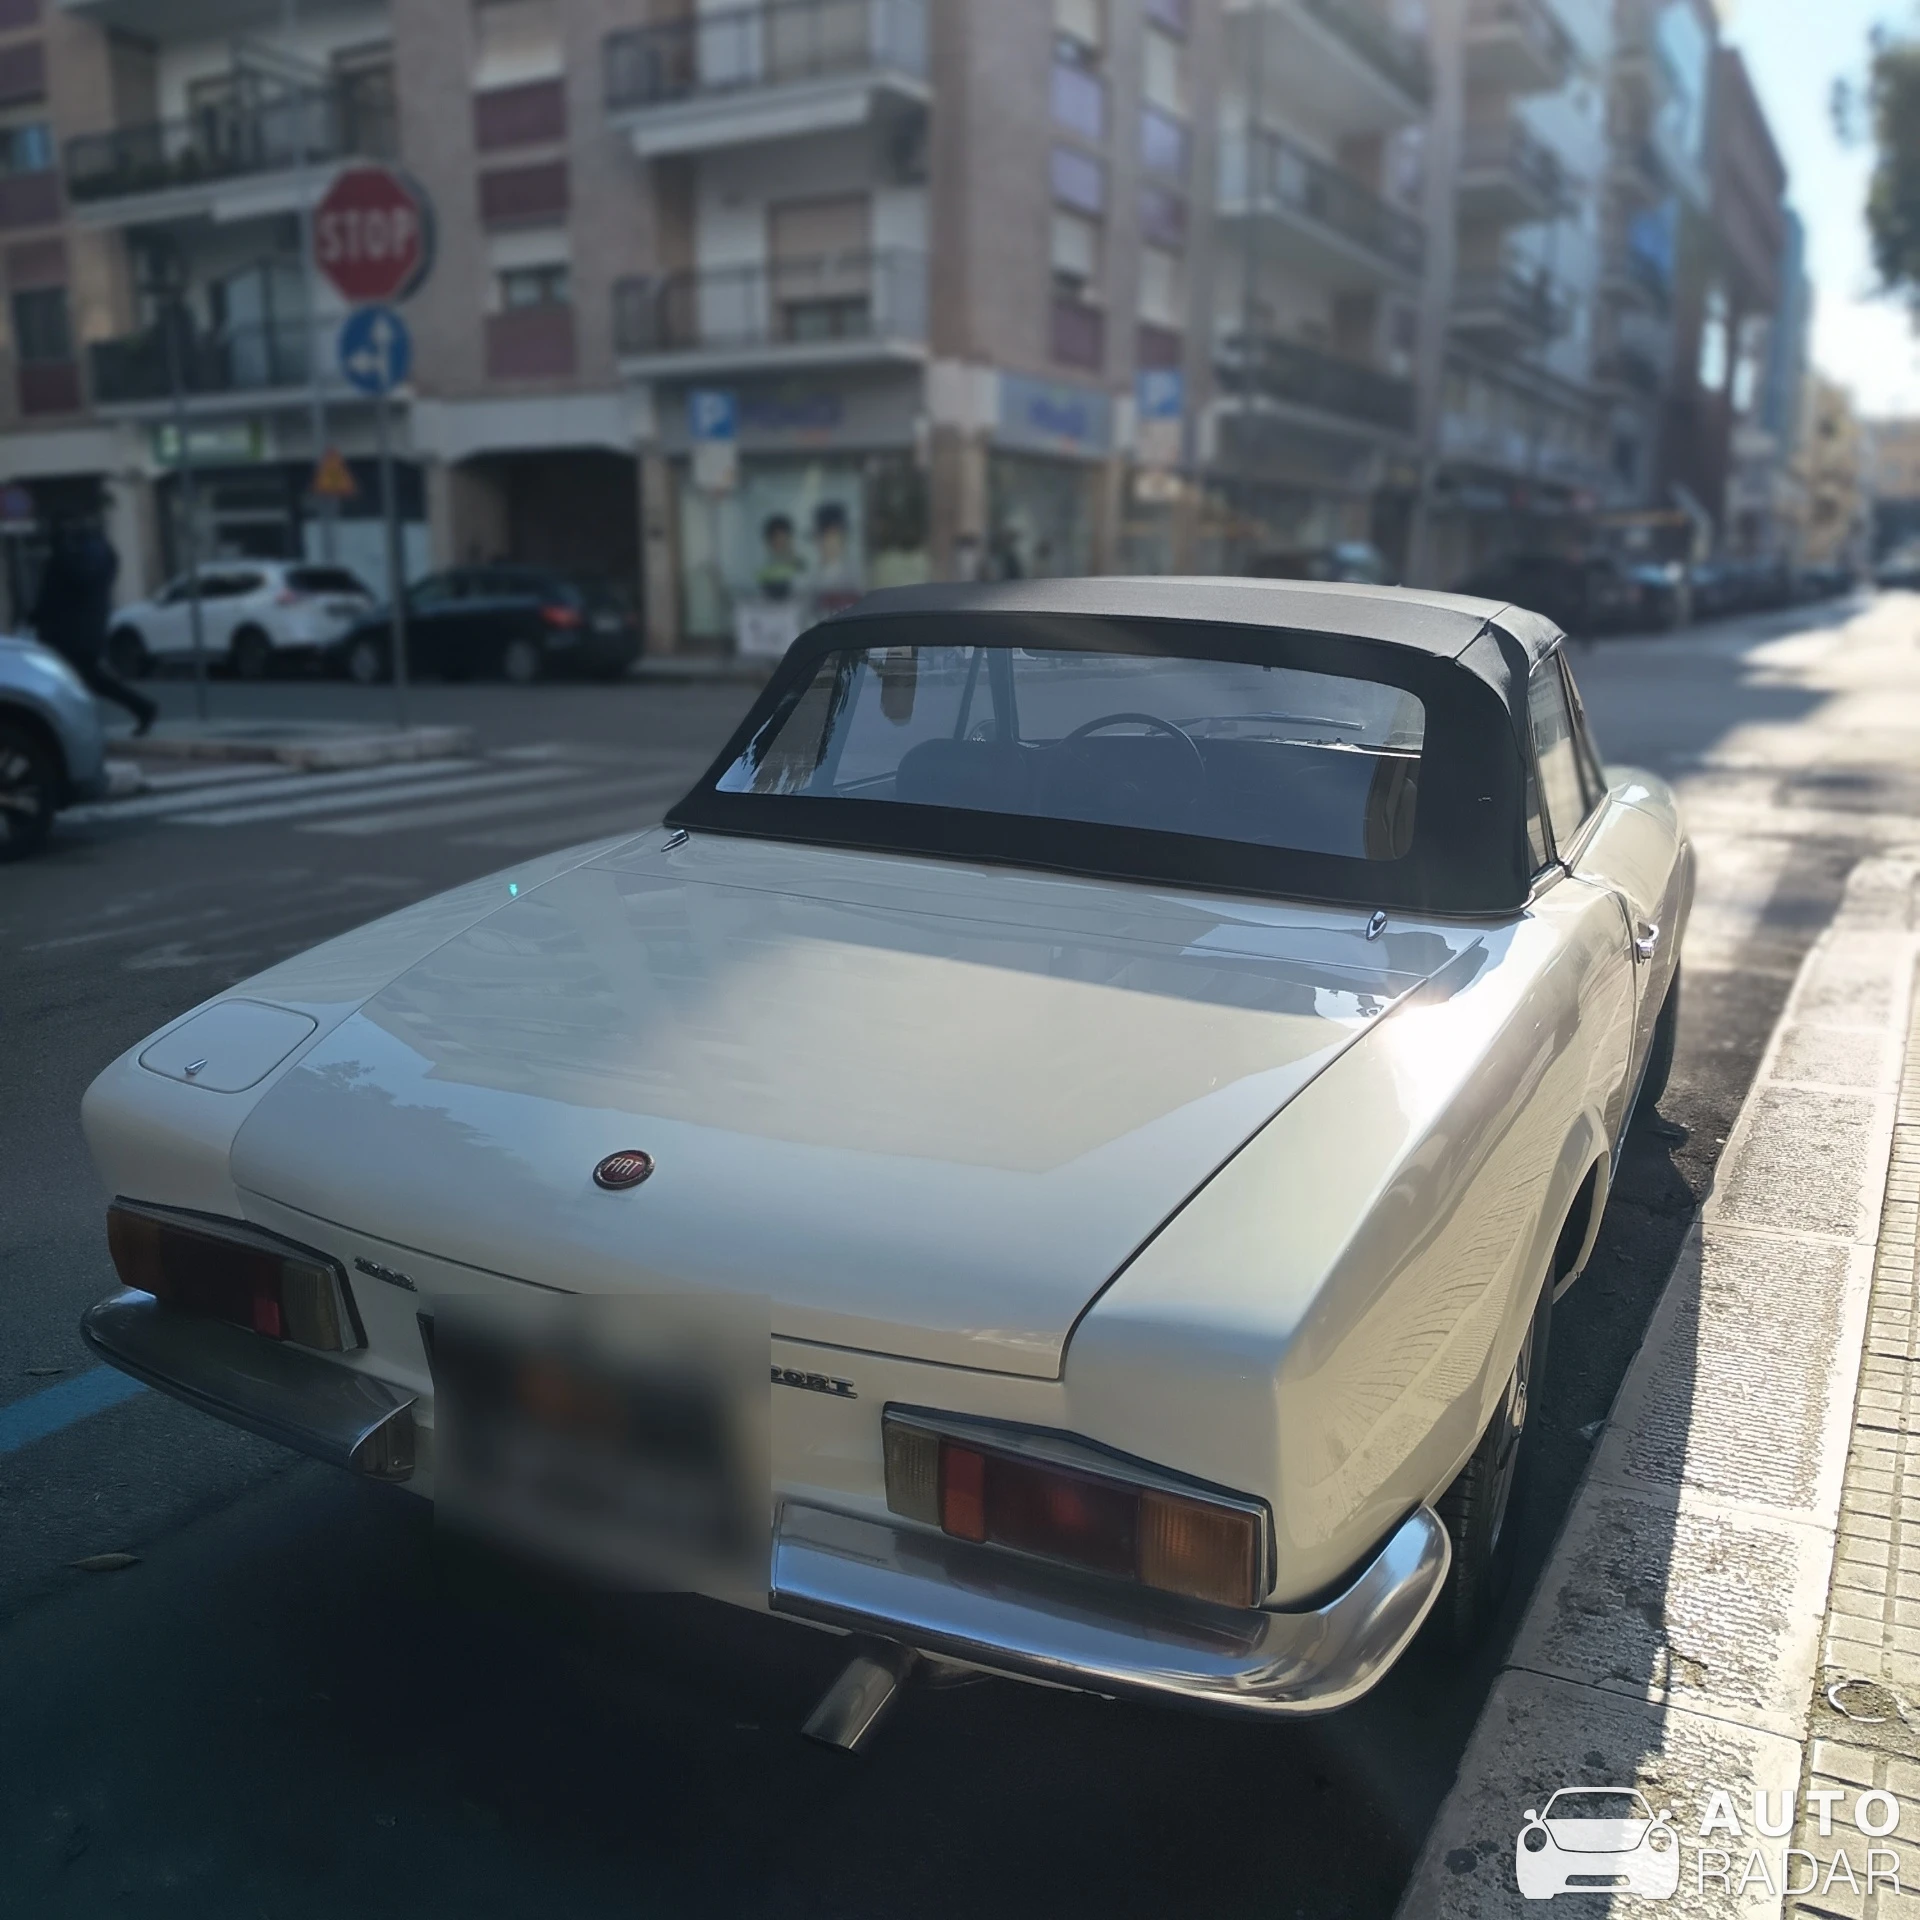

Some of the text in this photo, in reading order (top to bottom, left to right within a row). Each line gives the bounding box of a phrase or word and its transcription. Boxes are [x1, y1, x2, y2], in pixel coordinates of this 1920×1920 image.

[319, 207, 416, 262] STOP
[699, 395, 727, 432] P
[604, 1157, 643, 1176] FIAT
